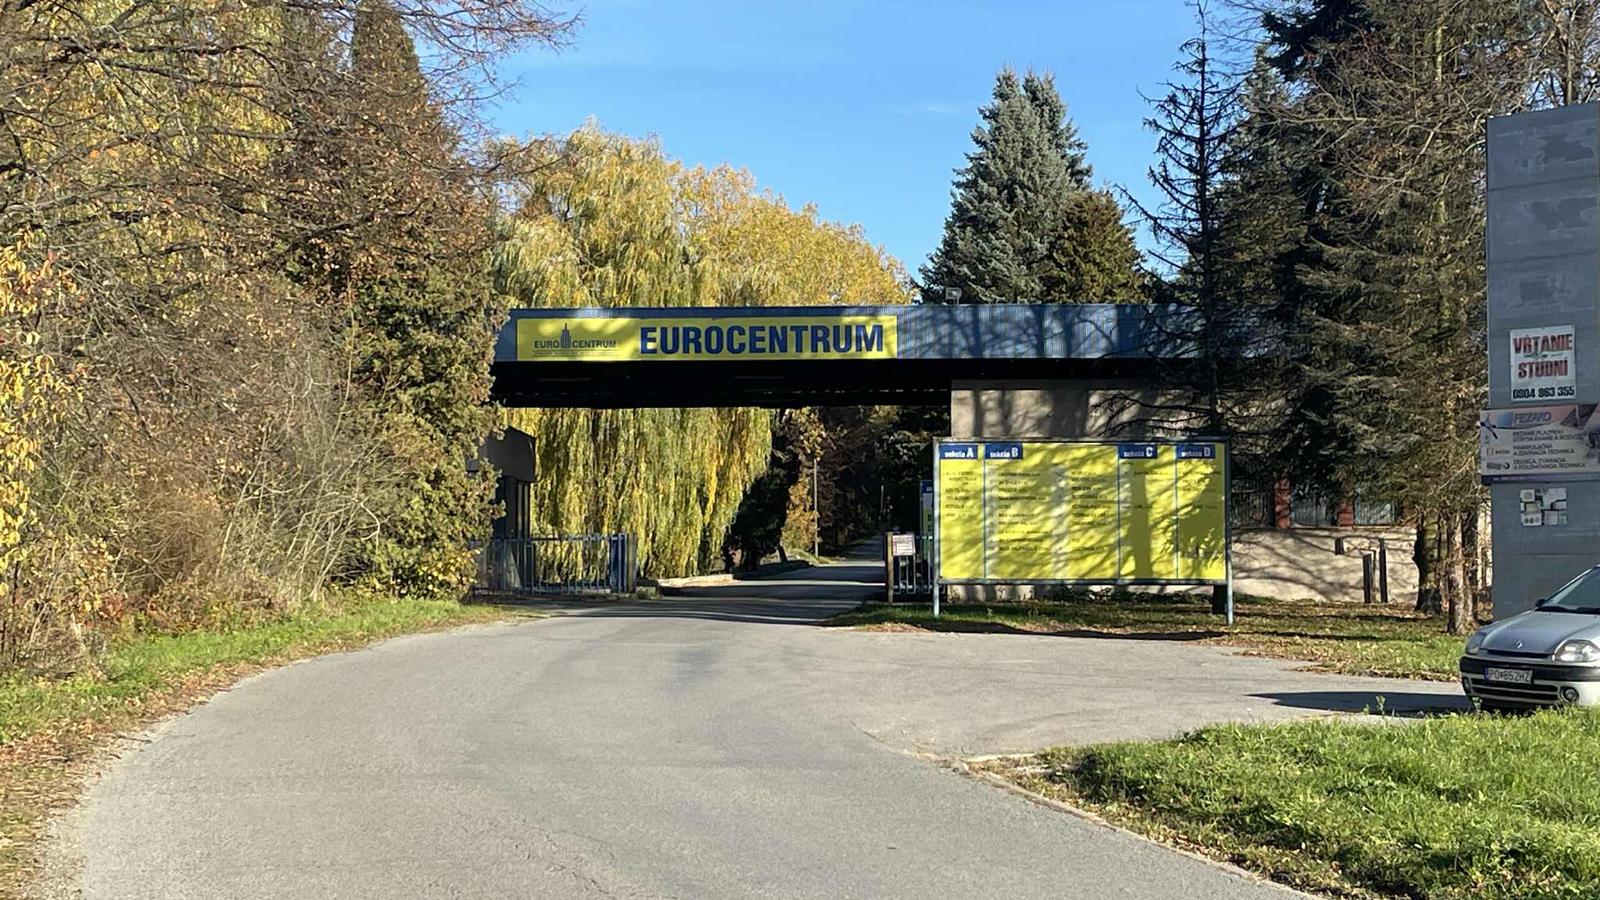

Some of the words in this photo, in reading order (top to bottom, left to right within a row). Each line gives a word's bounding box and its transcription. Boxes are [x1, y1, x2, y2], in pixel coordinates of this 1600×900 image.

[534, 340, 560, 349] EURO
[572, 339, 617, 348] CENTRUM
[640, 324, 883, 354] EUROCENTRUM
[1557, 386, 1575, 396] 355
[966, 447, 974, 458] A
[1011, 447, 1019, 457] B
[1145, 446, 1153, 457] C
[1203, 446, 1211, 457] D
